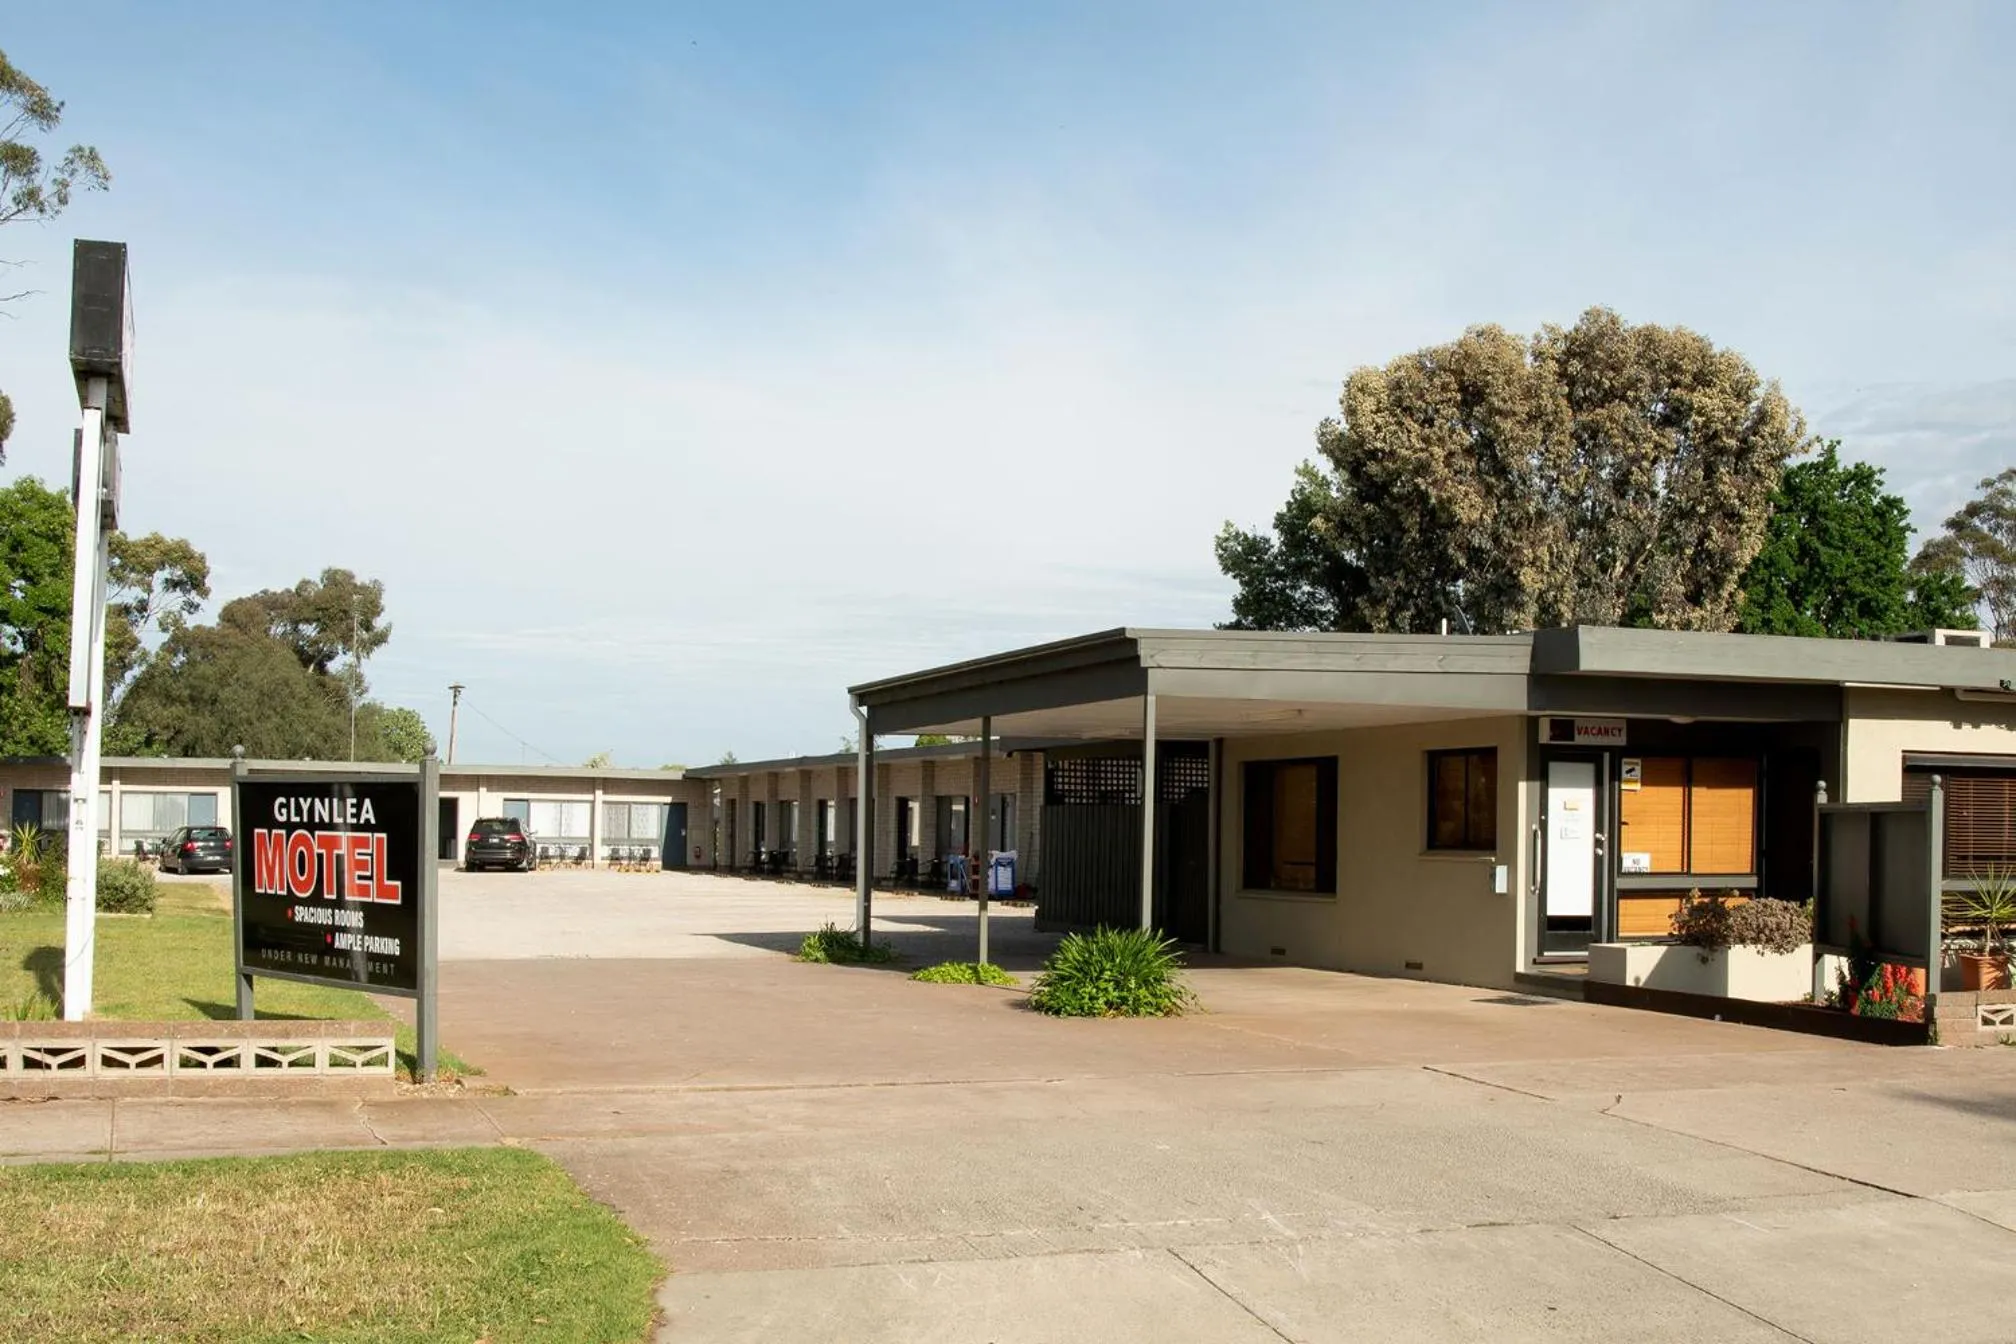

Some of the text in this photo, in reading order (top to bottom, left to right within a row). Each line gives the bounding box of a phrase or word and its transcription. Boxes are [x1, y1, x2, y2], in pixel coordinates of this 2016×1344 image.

[1577, 725, 1623, 737] VACANCY
[273, 796, 376, 825] GLYNLEA
[253, 828, 402, 905] MOTEL
[294, 905, 364, 929] SPACIOUS ROOMS
[261, 947, 293, 961] UNDER
[298, 952, 318, 965] NEW
[334, 932, 400, 956] AMPLE PARKING
